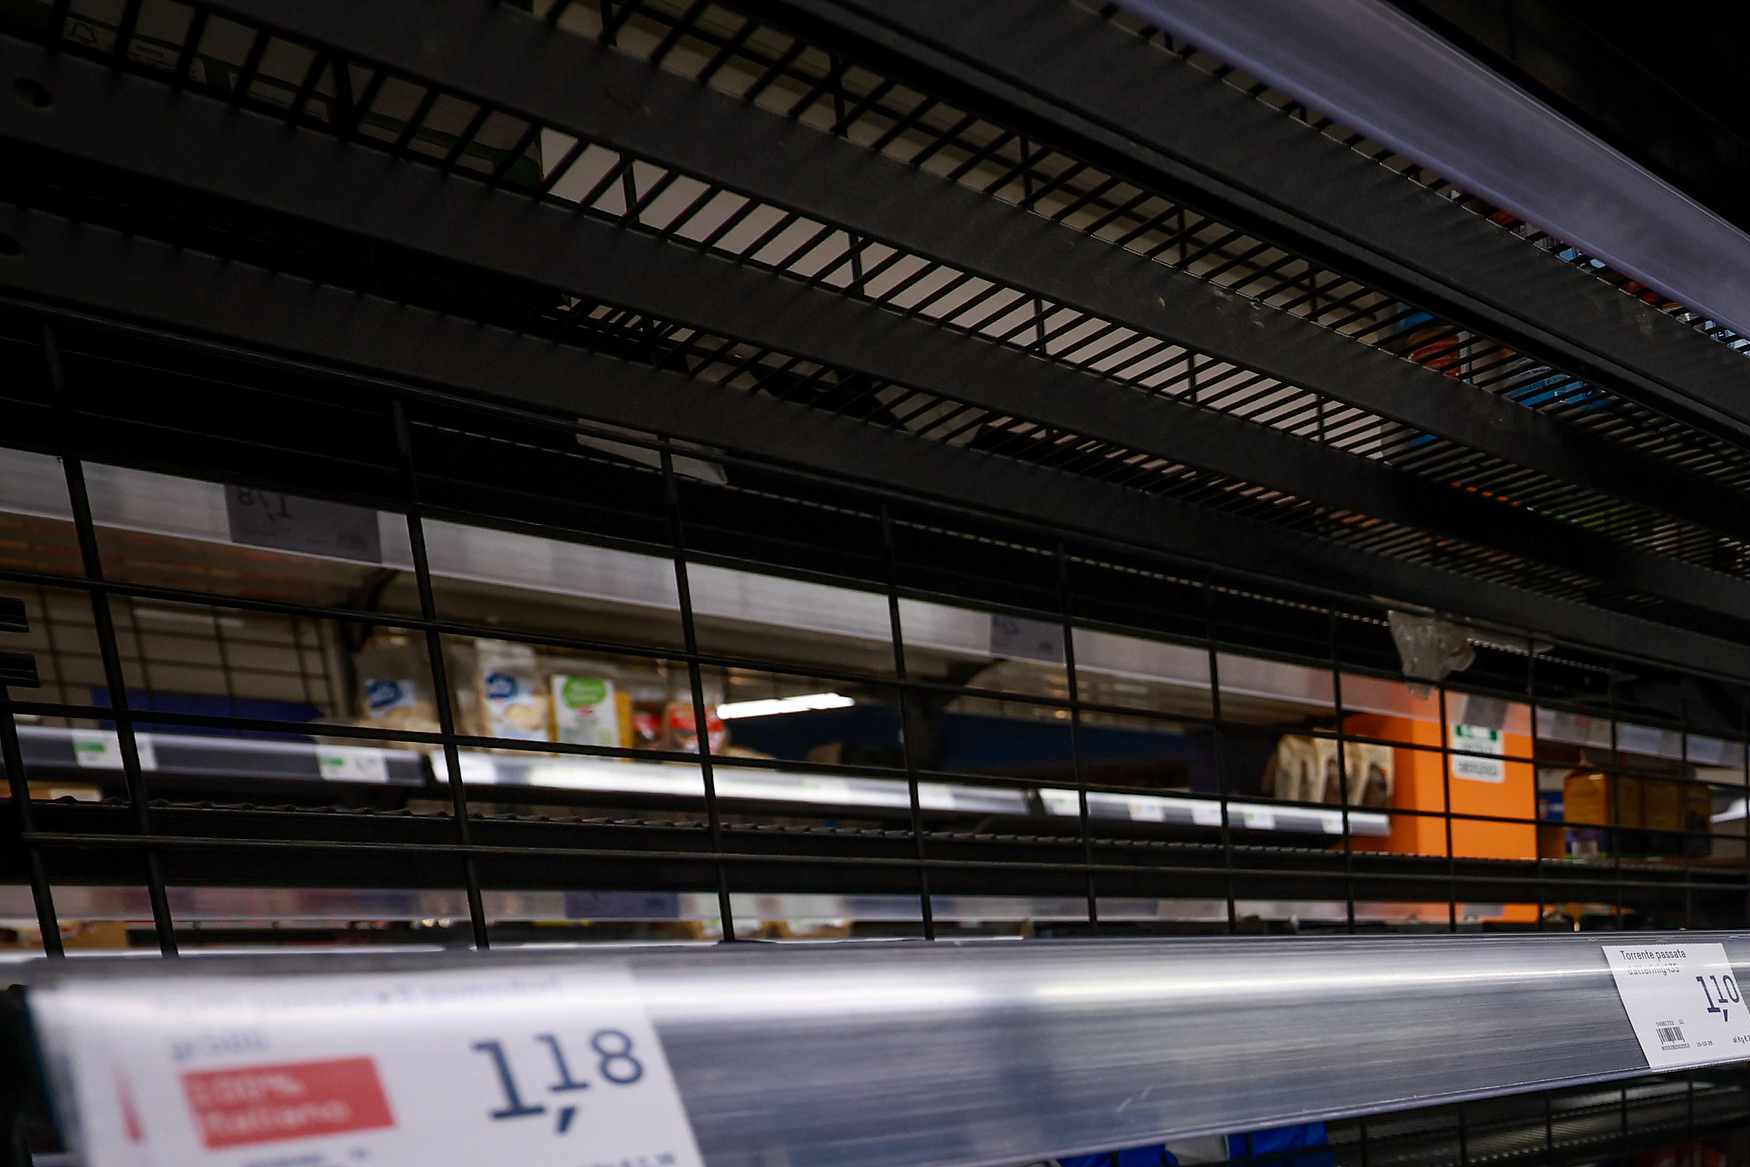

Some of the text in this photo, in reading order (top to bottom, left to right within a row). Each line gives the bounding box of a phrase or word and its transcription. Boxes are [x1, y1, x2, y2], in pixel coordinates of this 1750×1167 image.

[1620, 949, 1686, 961] Torrente passata
[1696, 974, 1740, 1022] 1,10
[471, 1028, 645, 1135] 1,18
